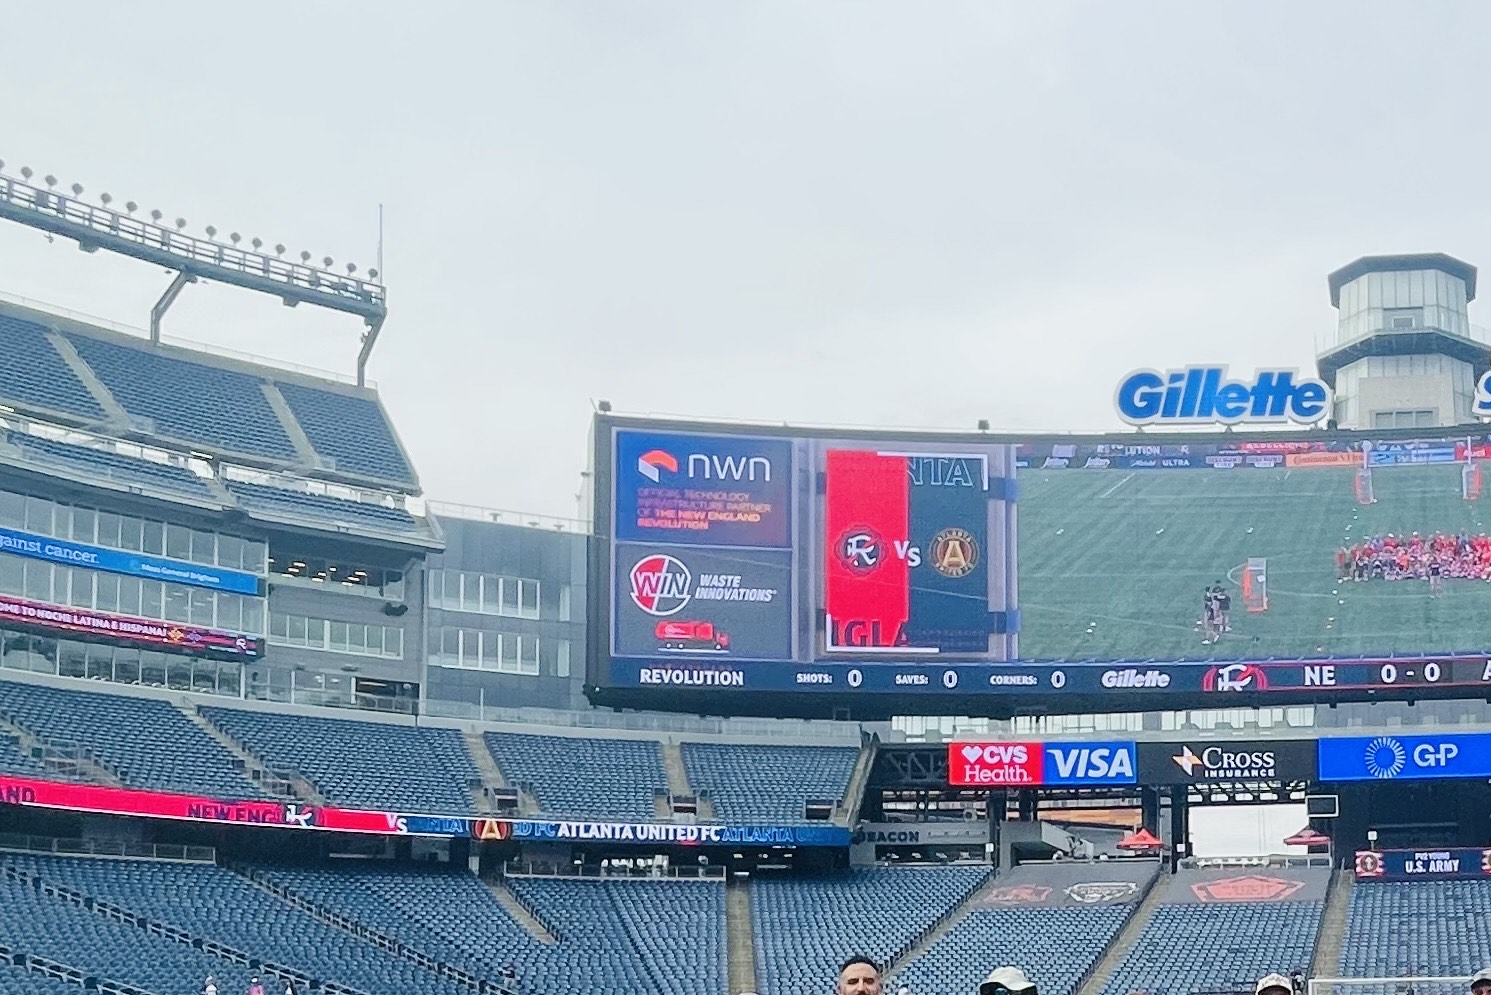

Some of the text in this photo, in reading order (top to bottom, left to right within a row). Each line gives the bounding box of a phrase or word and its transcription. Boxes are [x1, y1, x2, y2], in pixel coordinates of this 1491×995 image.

[1119, 367, 1327, 419] Gillette
[637, 518, 709, 530] REVOLUTION
[655, 509, 676, 519] THE
[678, 510, 706, 520] NEW
[707, 512, 761, 523] ENGLAND
[700, 574, 742, 588] WASTE
[21, 606, 35, 618] TO
[73, 613, 111, 631] LATINA
[640, 669, 745, 686] REVOLUTION
[796, 669, 863, 688] SHOTS: 0
[895, 670, 958, 689] SAVES: 0
[989, 671, 1066, 689] CORNERS: 0
[1101, 667, 1171, 690] Gillette
[1303, 665, 1337, 687] NE
[983, 745, 1028, 763] CVS
[1047, 748, 1134, 779] VISA
[1204, 769, 1275, 778] INSURANCE
[557, 822, 634, 840] ATLANTA
[636, 825, 698, 841] UNITED
[701, 827, 722, 842] FC
[1405, 860, 1460, 873] U.S. ARMY
